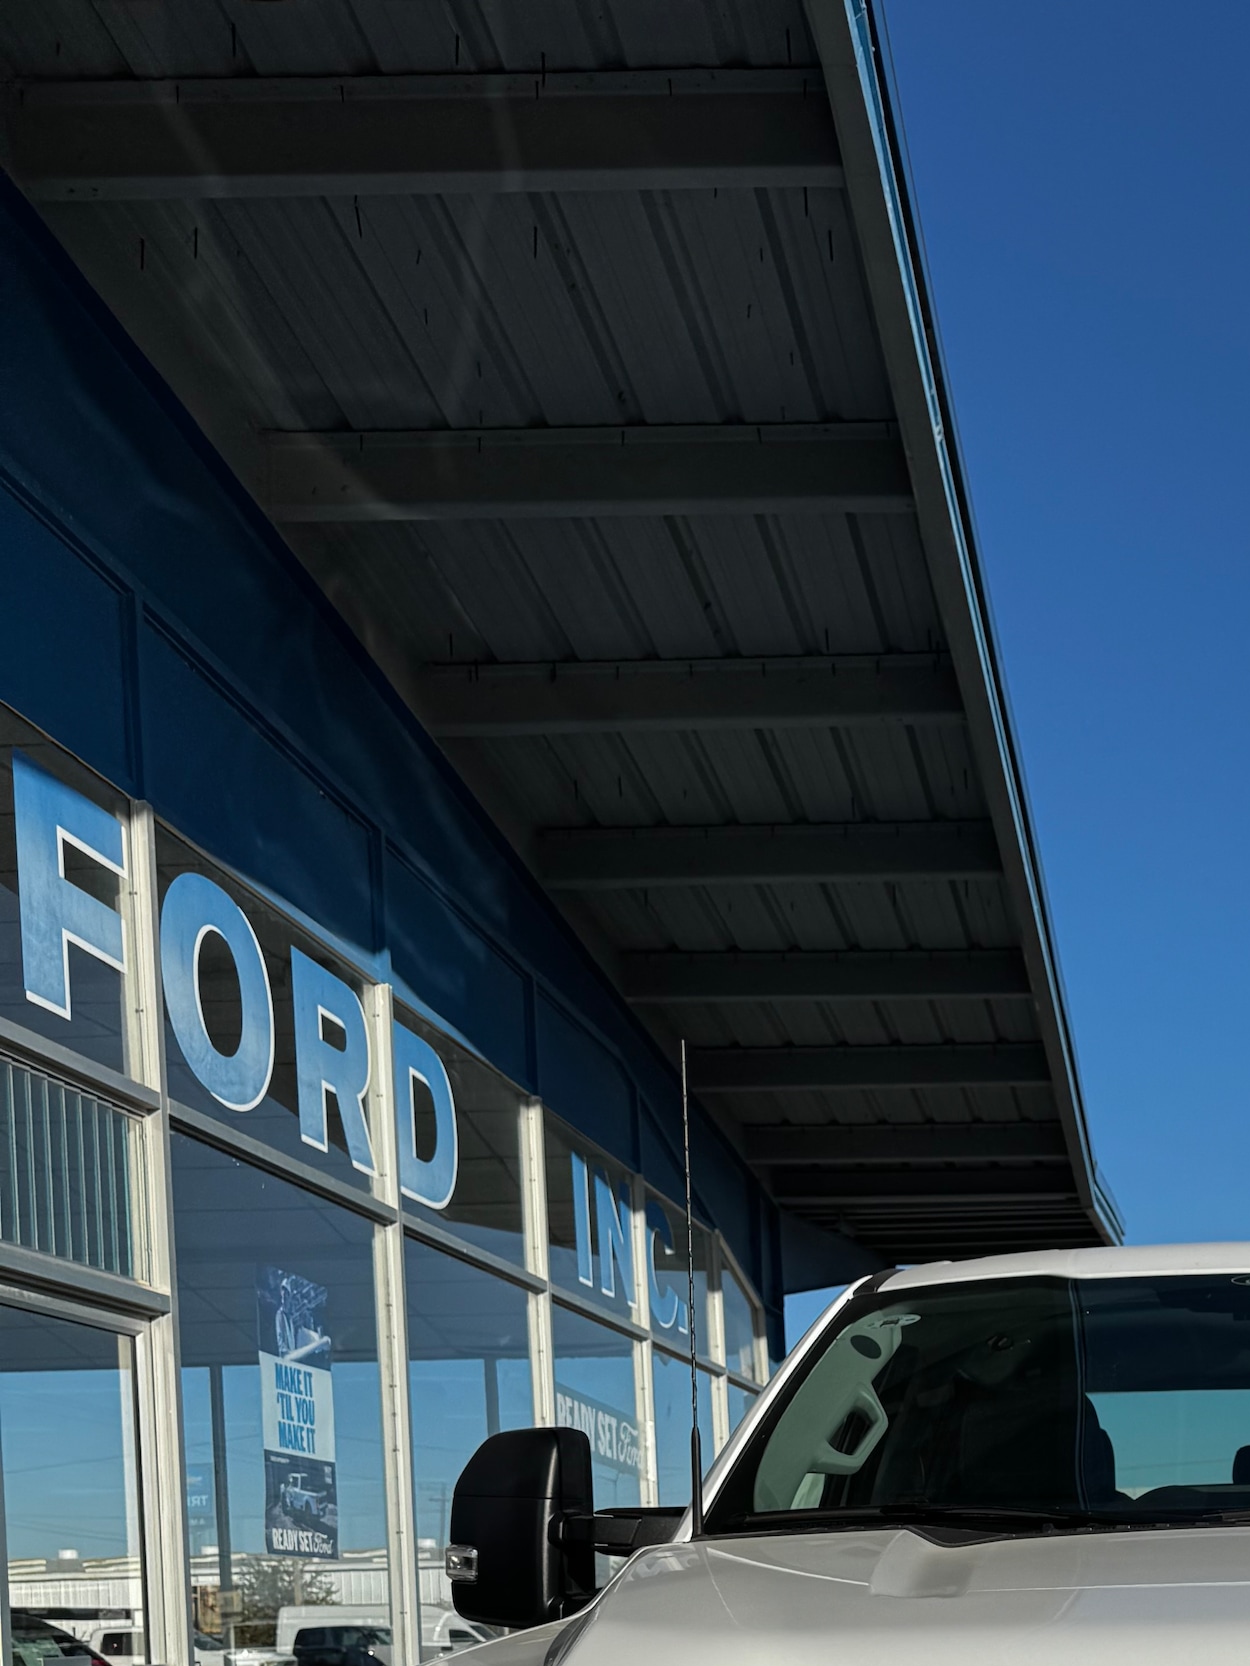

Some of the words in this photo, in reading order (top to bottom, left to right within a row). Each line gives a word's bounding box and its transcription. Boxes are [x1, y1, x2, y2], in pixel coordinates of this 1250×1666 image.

[12, 748, 460, 1210] FORD
[275, 1362, 304, 1396] MAKE
[303, 1370, 314, 1398] IT
[276, 1392, 294, 1422] 'TIL
[295, 1396, 316, 1426] YOU
[278, 1420, 306, 1452] MAKE
[306, 1426, 316, 1454] IT
[597, 1410, 618, 1460] SET
[272, 1527, 298, 1552] READY
[298, 1530, 313, 1553] SET
[313, 1531, 334, 1554] Ford
